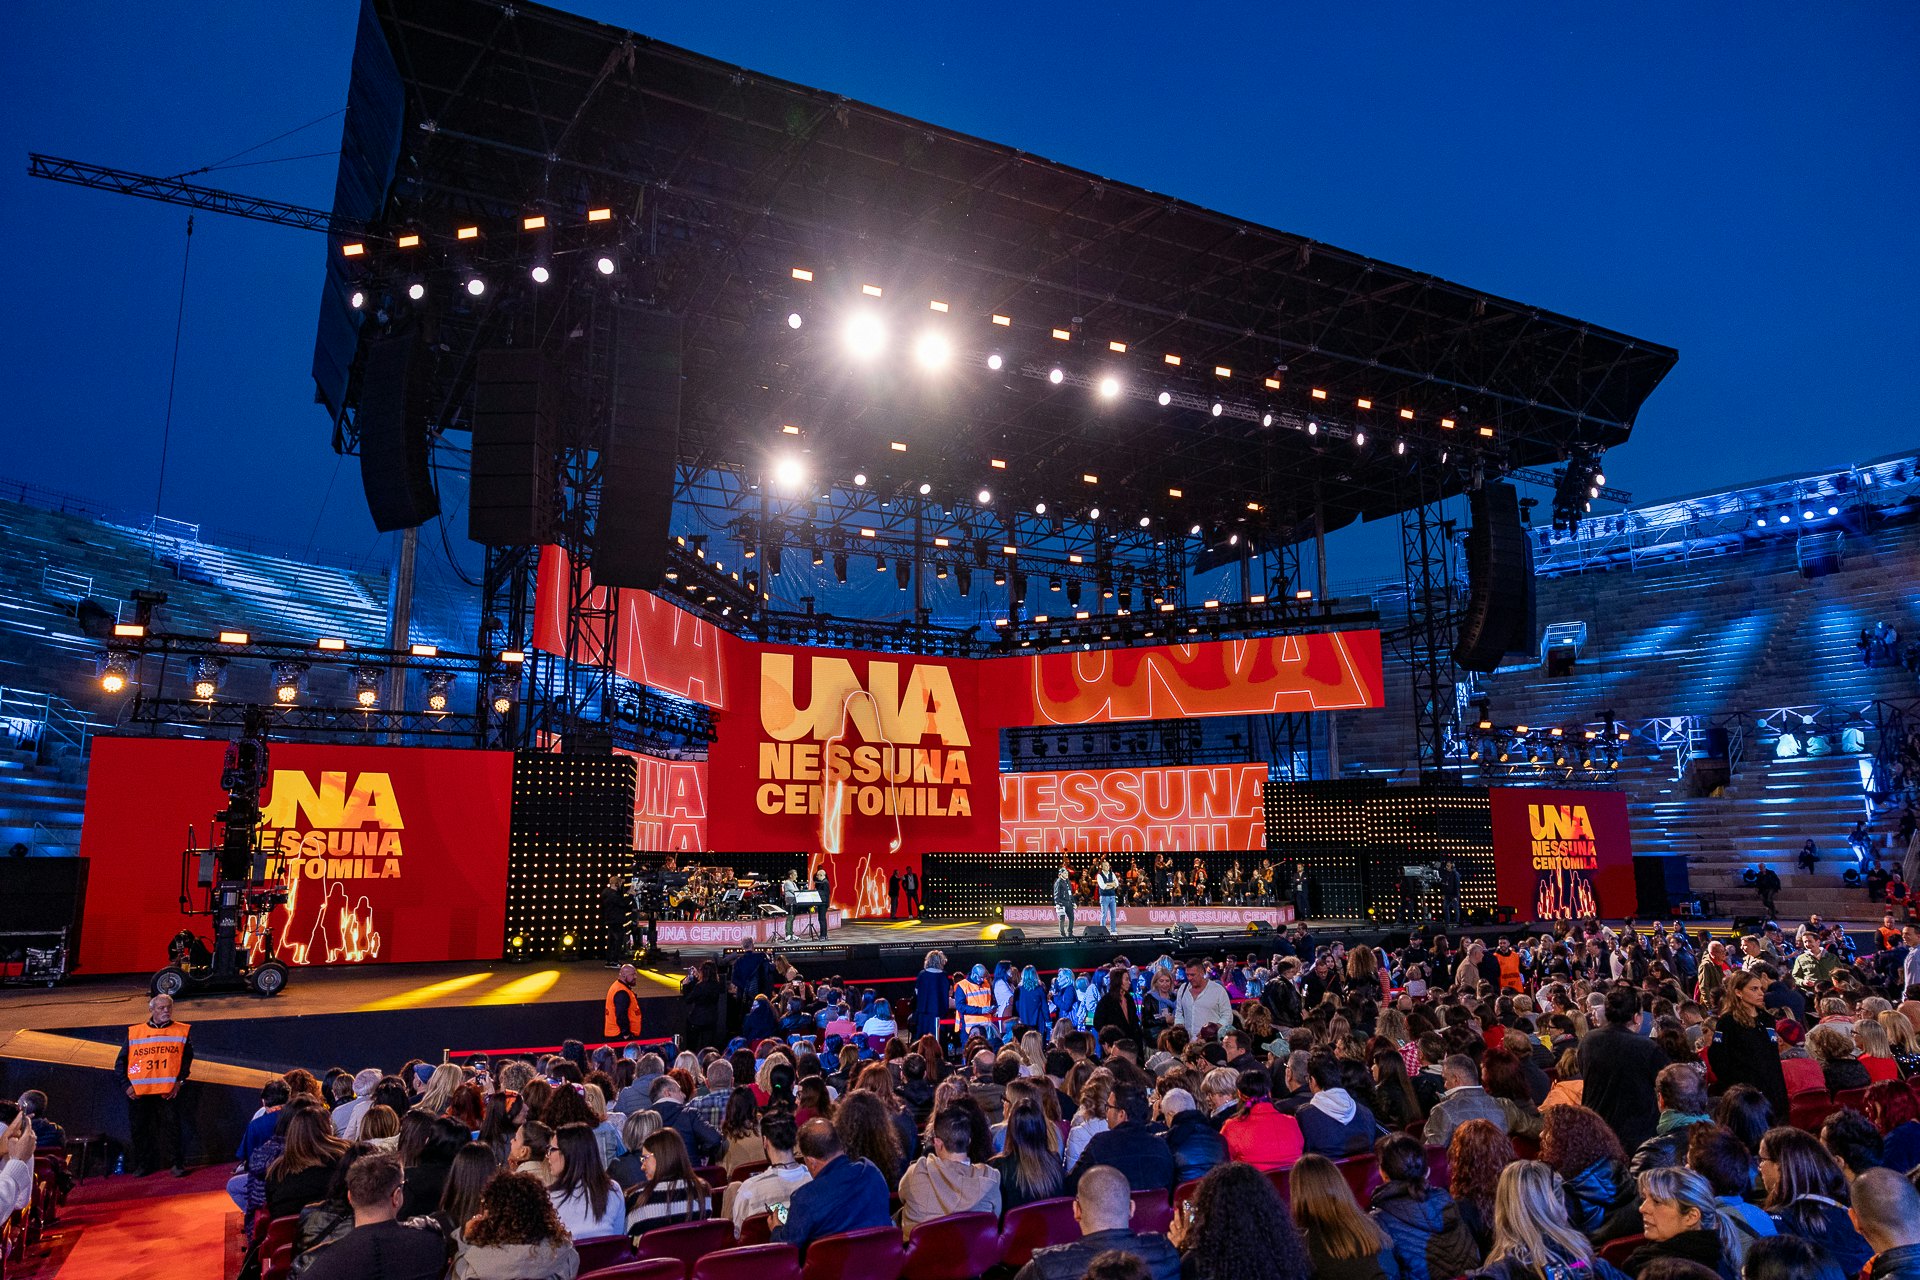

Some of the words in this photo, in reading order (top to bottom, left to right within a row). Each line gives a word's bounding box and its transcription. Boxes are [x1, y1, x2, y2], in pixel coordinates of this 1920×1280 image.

[1035, 632, 1367, 725] UNA
[760, 652, 972, 747] UNA
[759, 742, 972, 785] NESSUNA
[756, 782, 972, 817] CENTOMILA
[1527, 804, 1596, 841] UNA
[255, 830, 403, 857] ESSUNA
[1531, 840, 1597, 857] NESSUNA
[1532, 856, 1599, 871] CENTOMILA
[1150, 910, 1177, 922] UNA
[1179, 910, 1240, 923] NESSUNA
[133, 1045, 179, 1057] ASSISTENZA
[146, 1059, 168, 1070] 311
